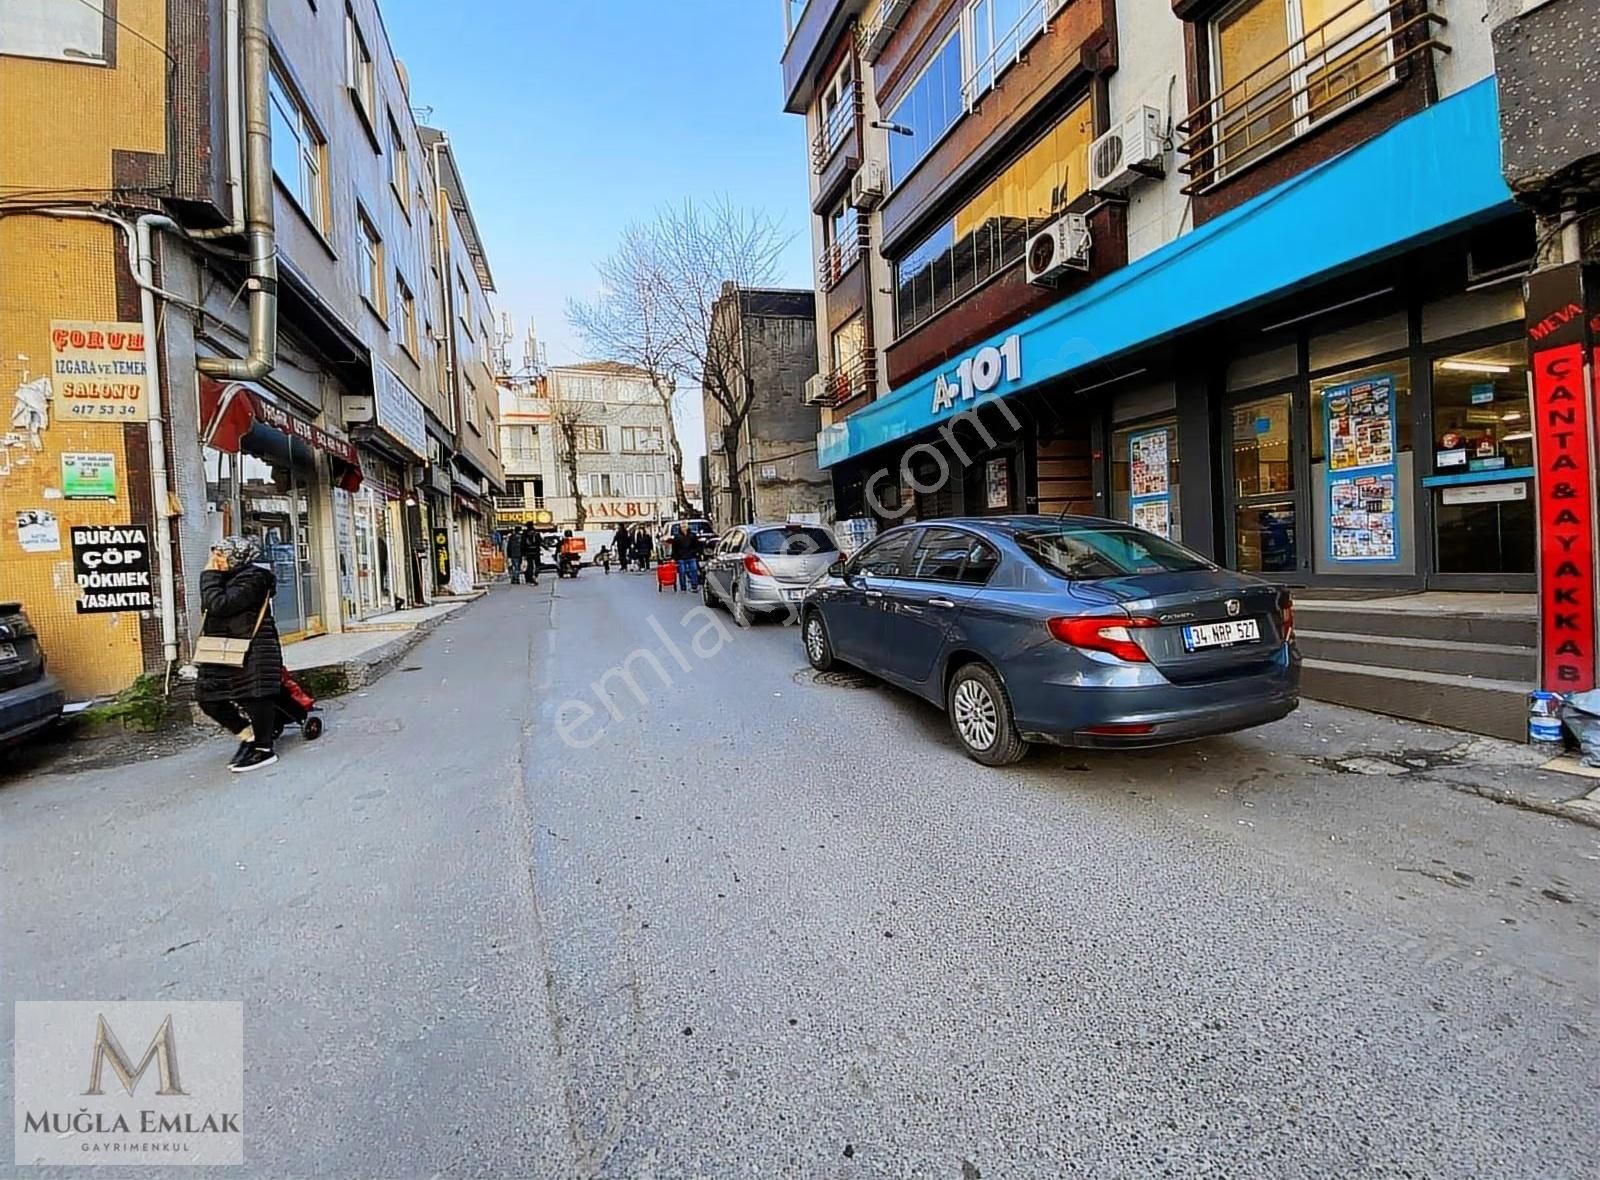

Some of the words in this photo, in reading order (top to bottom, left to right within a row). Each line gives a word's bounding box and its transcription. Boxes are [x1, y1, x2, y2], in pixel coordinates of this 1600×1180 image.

[1529, 303, 1584, 341] MEVA
[55, 360, 97, 374] IZGARA
[63, 382, 140, 400] SALONU
[99, 404, 115, 416] 53
[74, 530, 147, 545] BURAYA
[82, 547, 142, 569] ÇÖP
[77, 570, 150, 589] DÖKMEK
[81, 591, 152, 609] YASAKTIR
[1192, 627, 1208, 645] 34
[1211, 624, 1232, 642] NRP
[1236, 621, 1255, 639] 527
